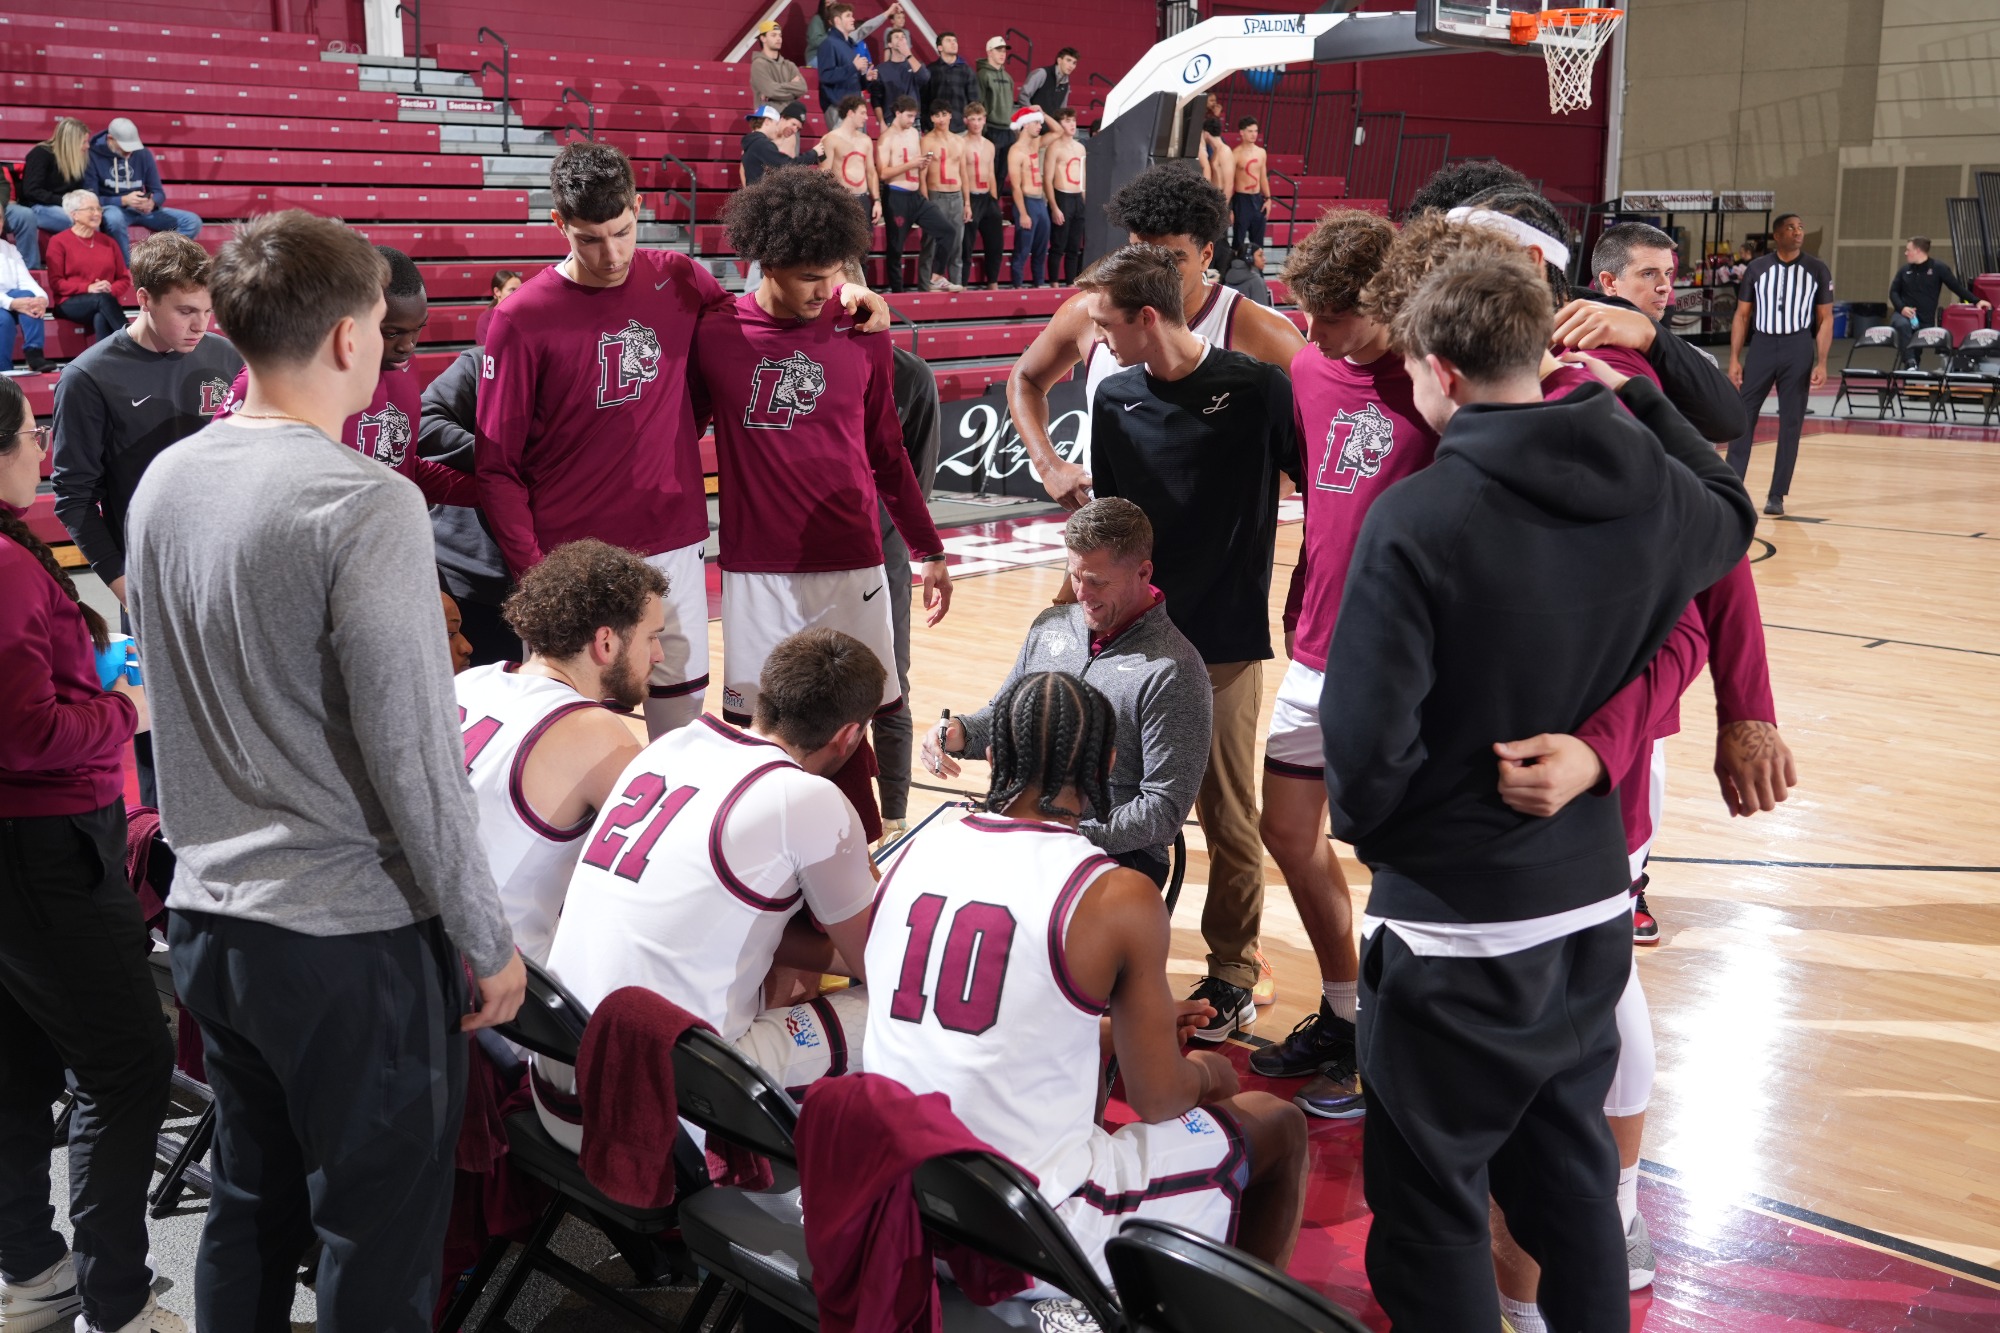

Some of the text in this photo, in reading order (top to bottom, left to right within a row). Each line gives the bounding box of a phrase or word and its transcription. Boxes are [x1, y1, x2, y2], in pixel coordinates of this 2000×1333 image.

[1243, 18, 1305, 34] SPALDING
[400, 98, 435, 108] Section 7
[448, 101, 476, 110] Section
[940, 147, 957, 184] L
[974, 151, 988, 189] L
[1244, 158, 1258, 190] S
[1658, 194, 1713, 203] CONCESSIONS
[482, 354, 495, 380] 13
[581, 771, 700, 884] 21
[890, 892, 1018, 1036] 10
